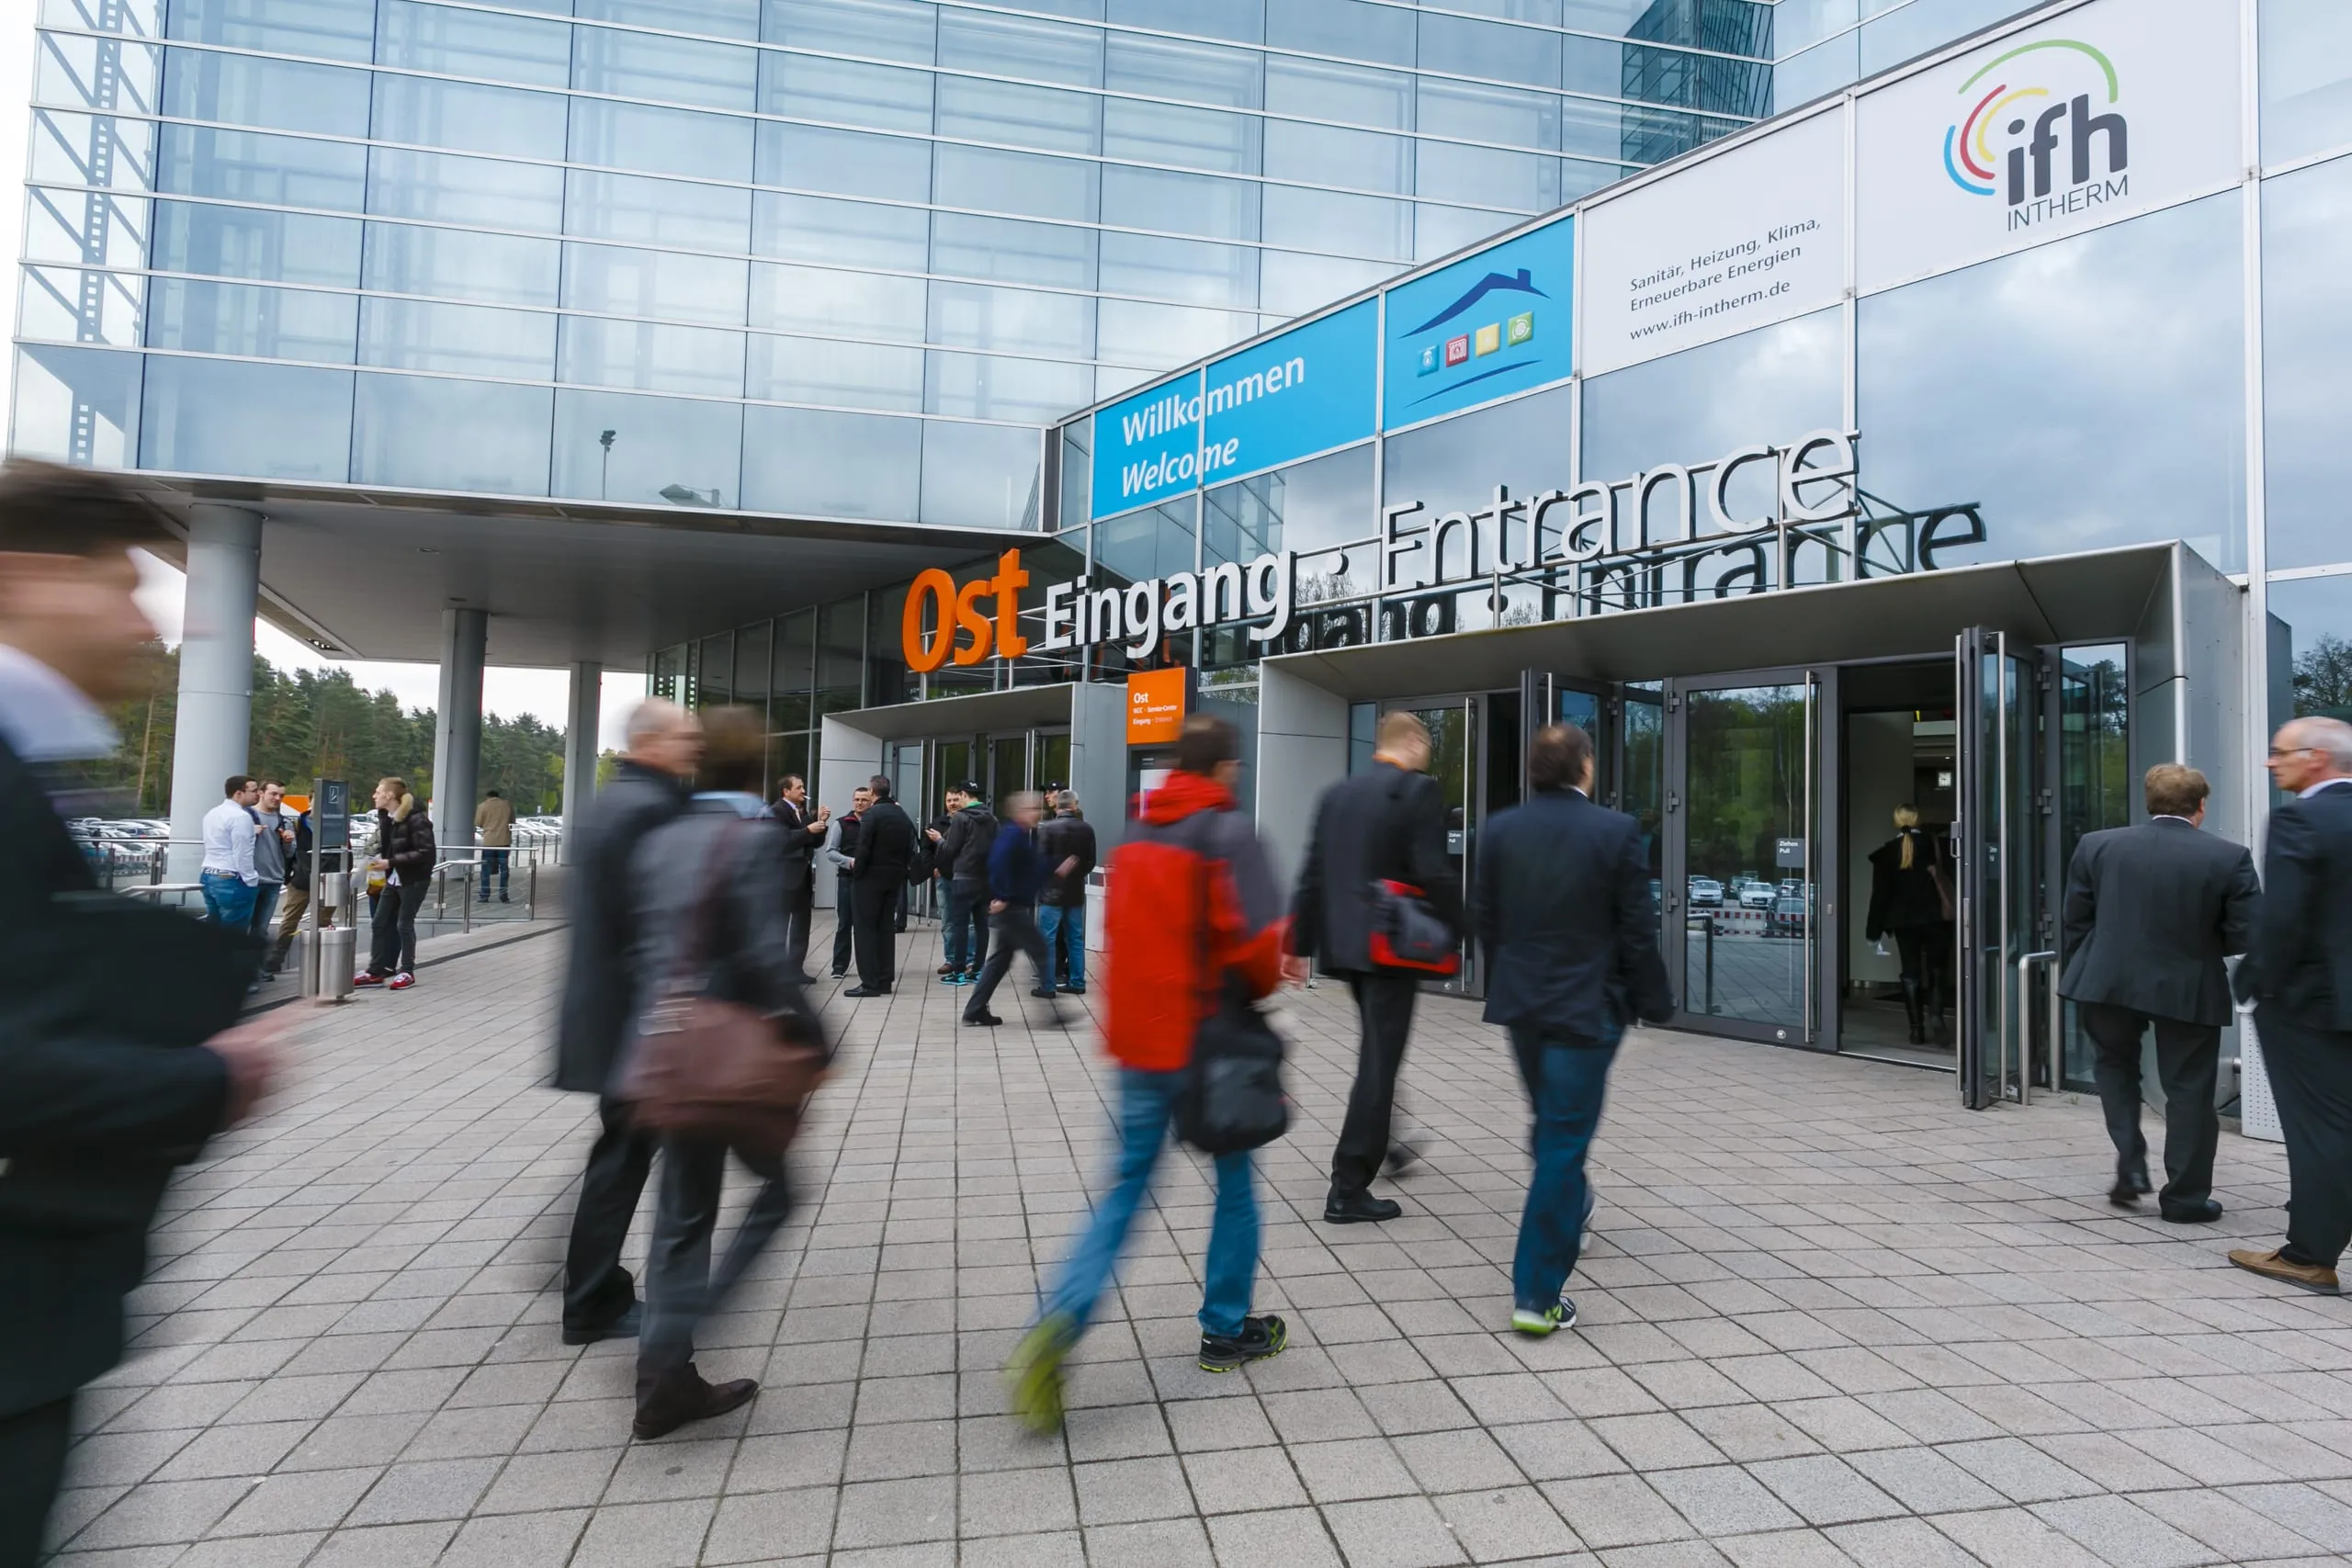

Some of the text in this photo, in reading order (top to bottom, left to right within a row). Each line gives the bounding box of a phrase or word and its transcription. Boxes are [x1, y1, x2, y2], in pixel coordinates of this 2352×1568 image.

[2007, 94, 2128, 207] ifh
[2007, 175, 2129, 231] INTHERM
[1630, 218, 1821, 292] Sanitär, Heizung, Klima,
[1631, 246, 1801, 311] Erneuerbare Energien
[1630, 279, 1790, 340] www.ifh-intherm.de
[1123, 356, 1305, 446] Willkommen
[1122, 436, 1239, 498] Welcome
[902, 548, 1029, 672] Ost
[1046, 550, 1297, 659] Eingang
[1383, 427, 1861, 592] Entrance
[1133, 693, 1148, 704] Ost
